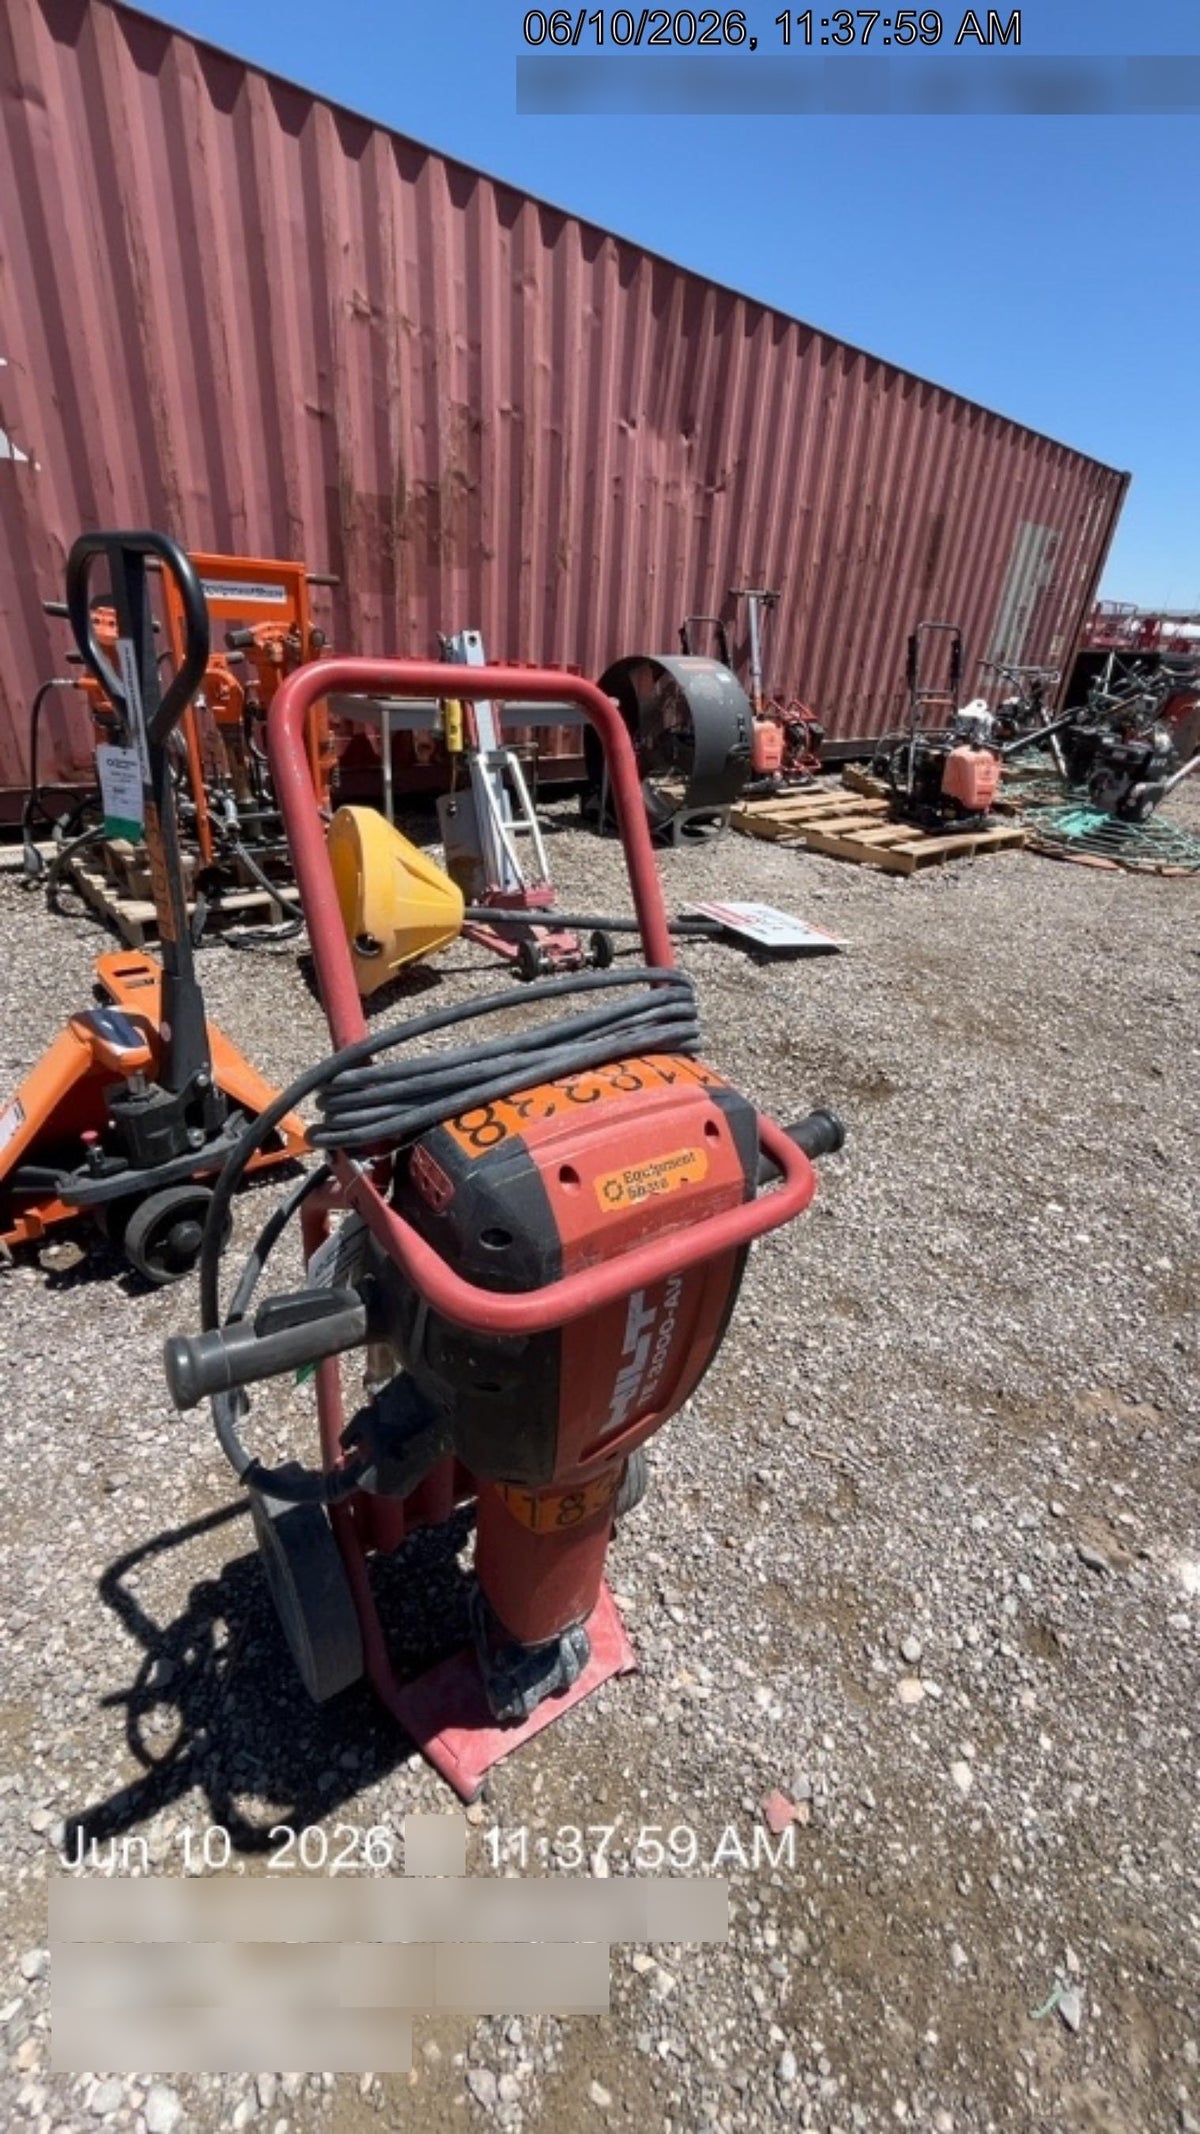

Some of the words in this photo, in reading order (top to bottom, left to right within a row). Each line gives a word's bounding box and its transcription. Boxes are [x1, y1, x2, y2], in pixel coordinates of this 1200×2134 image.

[623, 1152, 696, 1183] Equipment
[599, 1289, 658, 1435] HILT
[647, 1271, 683, 1380] 3000-AV
